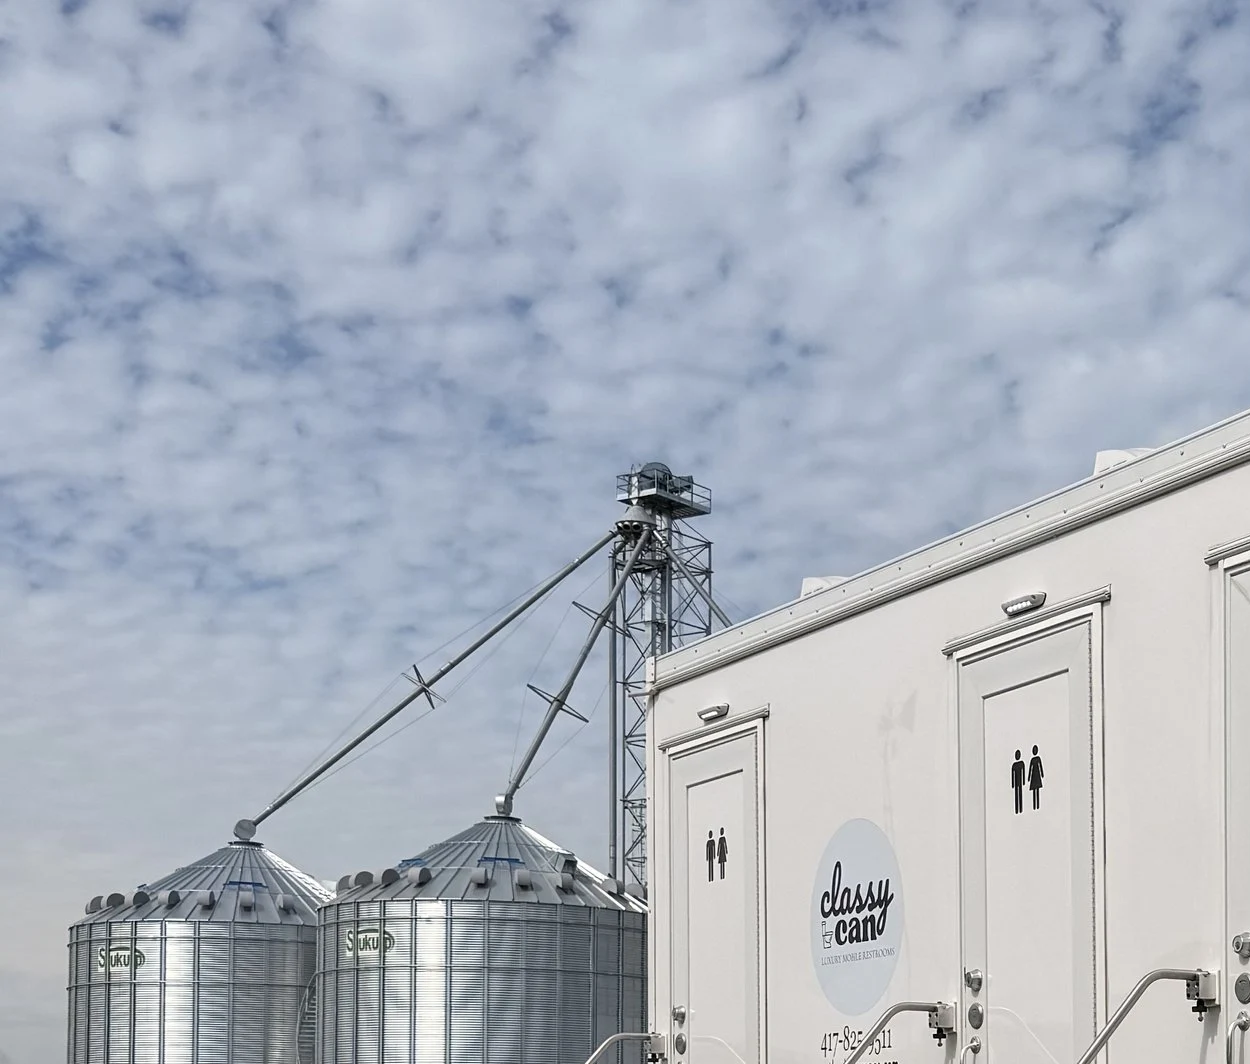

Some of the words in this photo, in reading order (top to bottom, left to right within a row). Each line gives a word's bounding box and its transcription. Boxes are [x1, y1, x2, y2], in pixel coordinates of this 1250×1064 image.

[820, 861, 894, 936] classy
[835, 914, 877, 946] can
[821, 954, 842, 966] LUXURY
[842, 951, 862, 963] MOBILE
[862, 947, 895, 960] RESTROOMS
